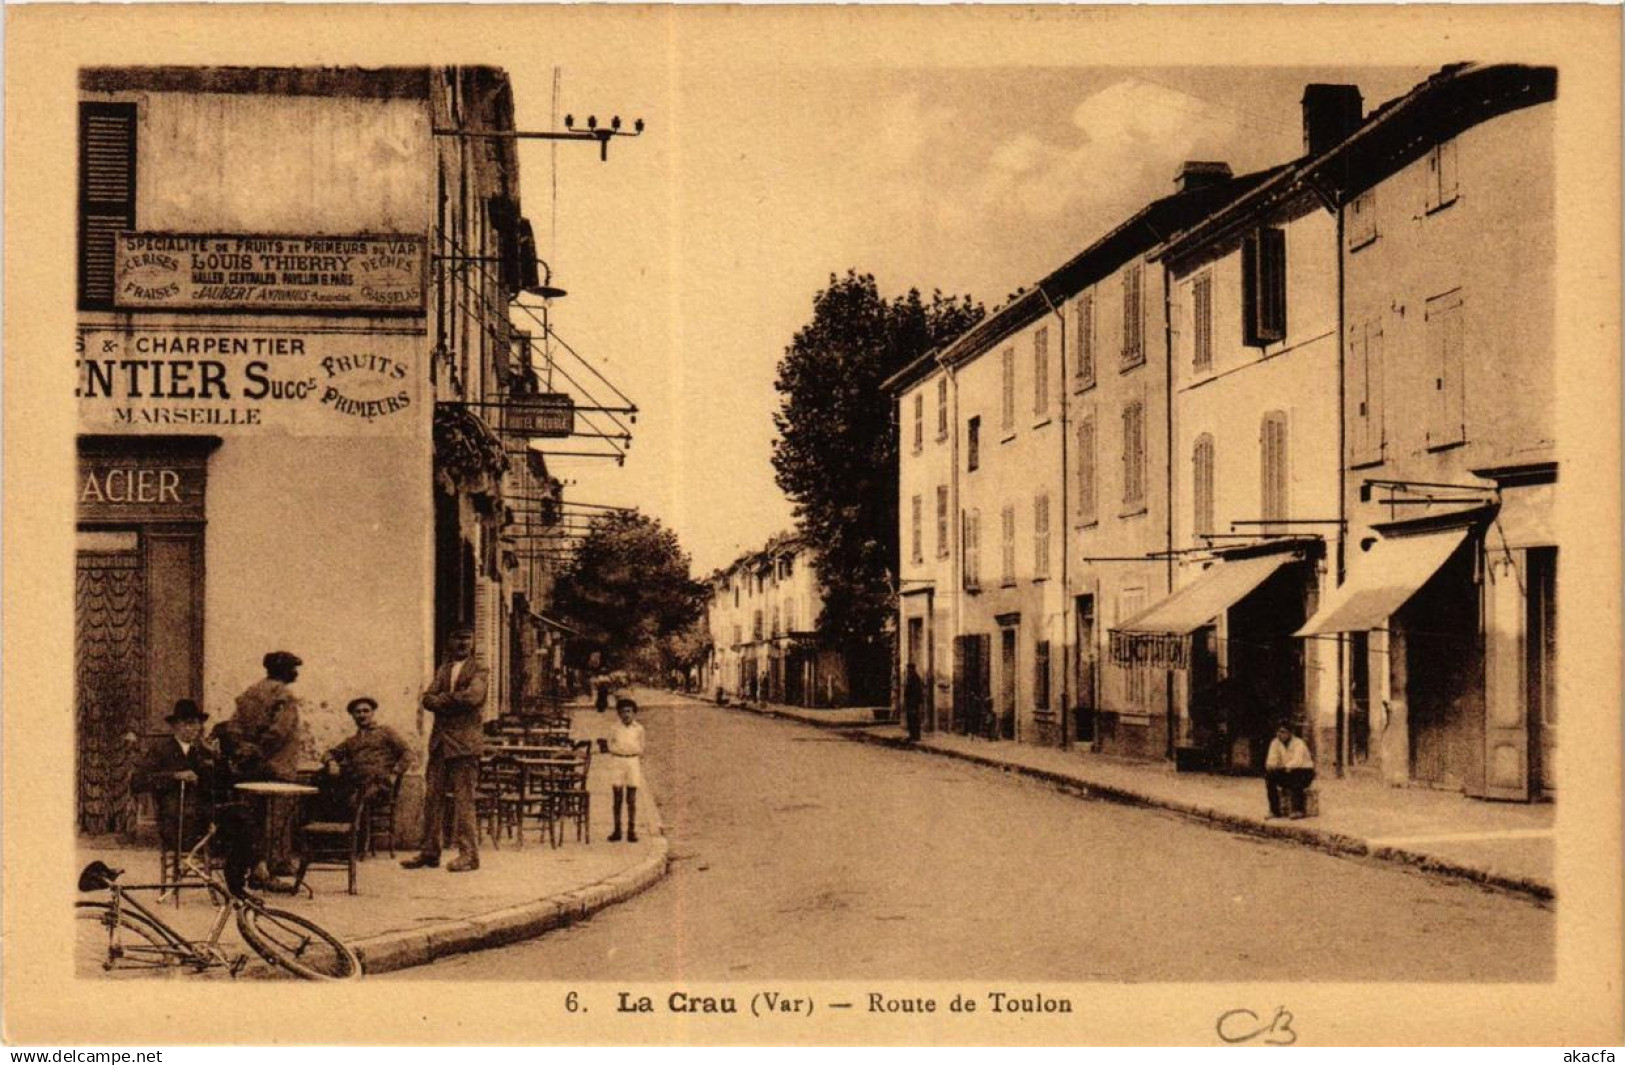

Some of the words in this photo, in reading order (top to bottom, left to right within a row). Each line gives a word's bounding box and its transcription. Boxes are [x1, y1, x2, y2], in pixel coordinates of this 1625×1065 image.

[237, 240, 284, 253] FRUITS
[304, 241, 367, 254] PRIMEURS
[387, 241, 417, 255] VAR
[126, 253, 179, 272] CERISES
[191, 253, 253, 270] LOUIS
[259, 254, 355, 272] THIERRY
[124, 282, 180, 299] FRAISES
[102, 339, 119, 353] &
[135, 336, 305, 356] CHARPENTIER
[321, 353, 408, 379] FRUITS
[320, 385, 411, 419] PRIMEURS
[114, 407, 261, 426] MARSEILLE
[80, 469, 182, 503] ACIER
